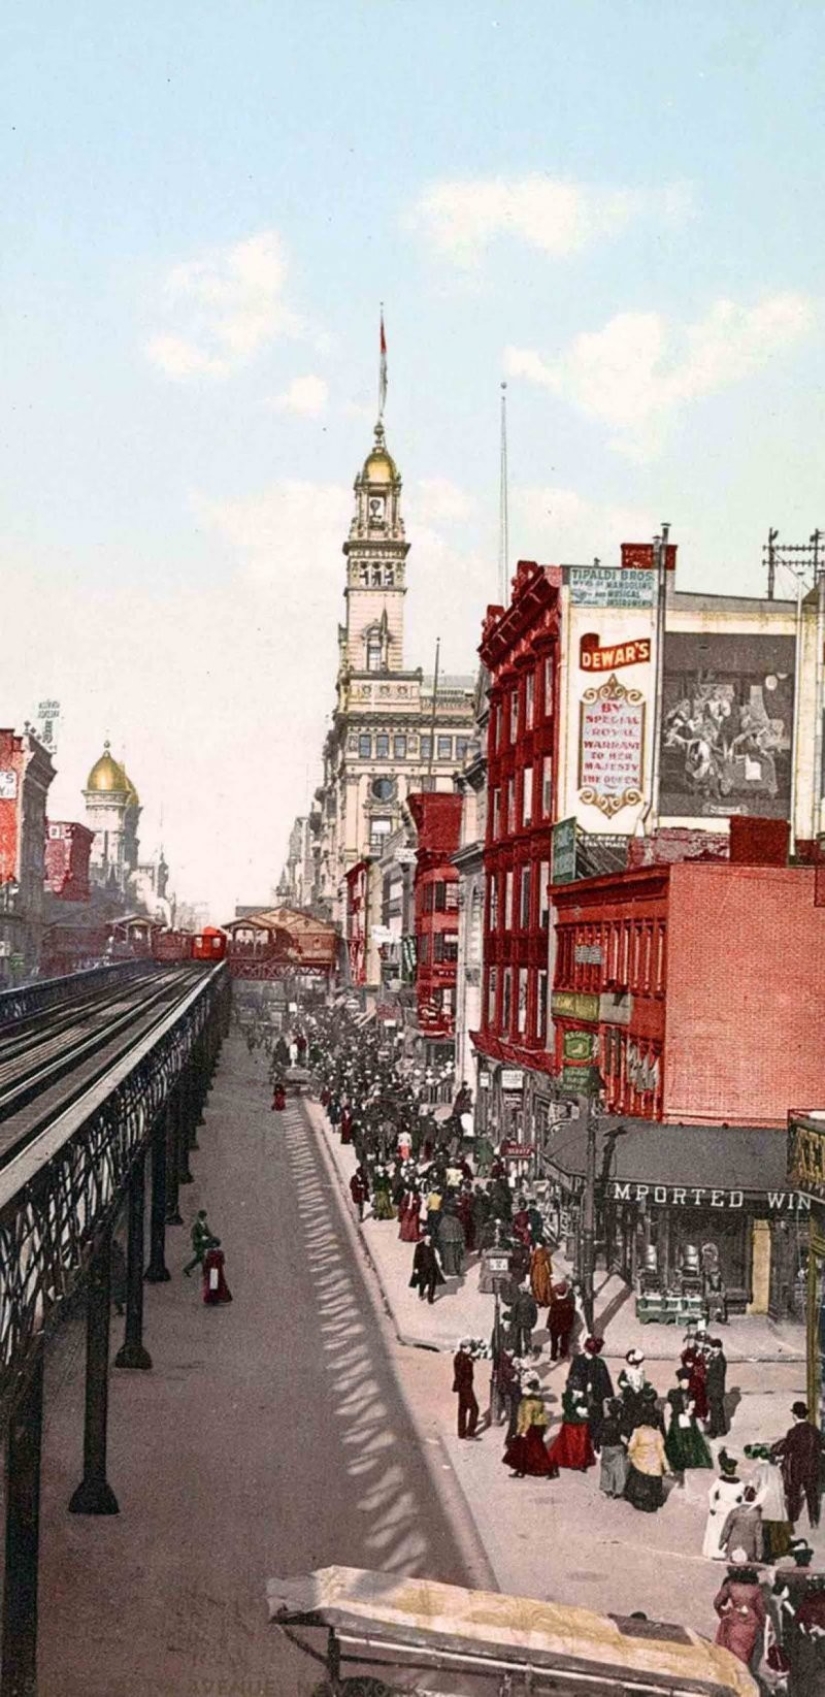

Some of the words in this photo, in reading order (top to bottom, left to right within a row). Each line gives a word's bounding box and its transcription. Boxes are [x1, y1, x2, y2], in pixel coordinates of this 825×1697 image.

[572, 569, 616, 580] TIPALDI
[582, 642, 649, 668] DEWAR'S
[601, 703, 622, 713] BY
[586, 715, 639, 725] SPECIAL
[592, 728, 637, 737] ROYAL
[584, 741, 640, 750] WARRANT
[591, 752, 604, 760] TO
[609, 752, 632, 760] HER
[585, 762, 638, 771] MAJESTY
[583, 775, 599, 783] THE
[604, 776, 638, 784] QUEEN
